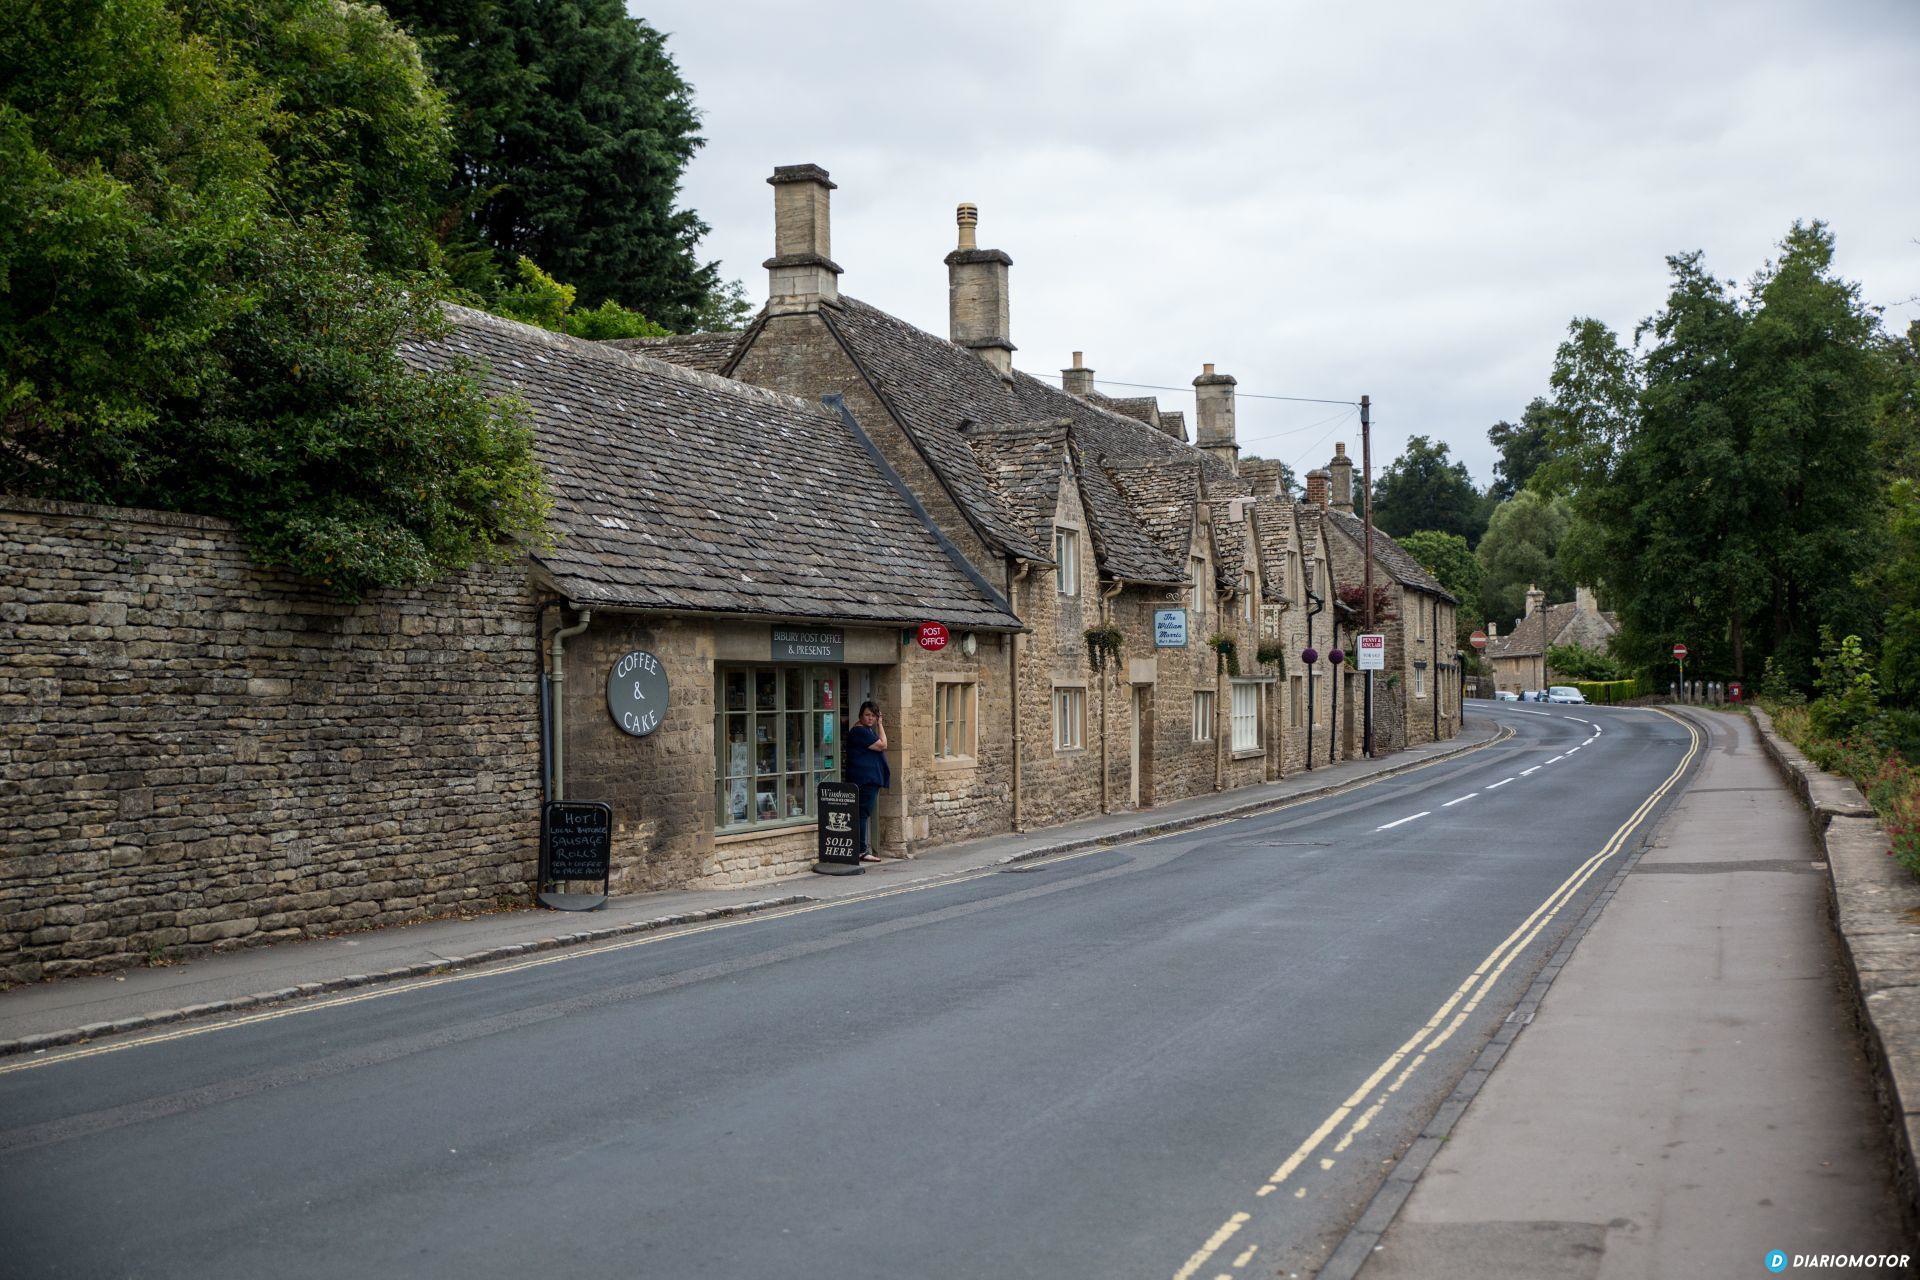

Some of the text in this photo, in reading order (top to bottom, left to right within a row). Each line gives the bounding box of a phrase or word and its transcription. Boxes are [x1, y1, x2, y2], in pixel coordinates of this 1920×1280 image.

[1163, 613, 1176, 621] The
[1157, 622, 1183, 630] William
[923, 627, 941, 636] POST
[1159, 631, 1182, 639] Morris
[774, 631, 842, 644] BIBURY POST OFFICE
[921, 637, 945, 646] OFFICE
[788, 644, 831, 656] & PRESENTS
[618, 652, 658, 678] COFFEE
[633, 681, 645, 700] &
[624, 710, 658, 732] CAKE
[551, 836, 604, 847] SAUSAGE
[826, 837, 853, 847] SOLD
[557, 848, 598, 859] ROLLS
[825, 847, 854, 857] HERE
